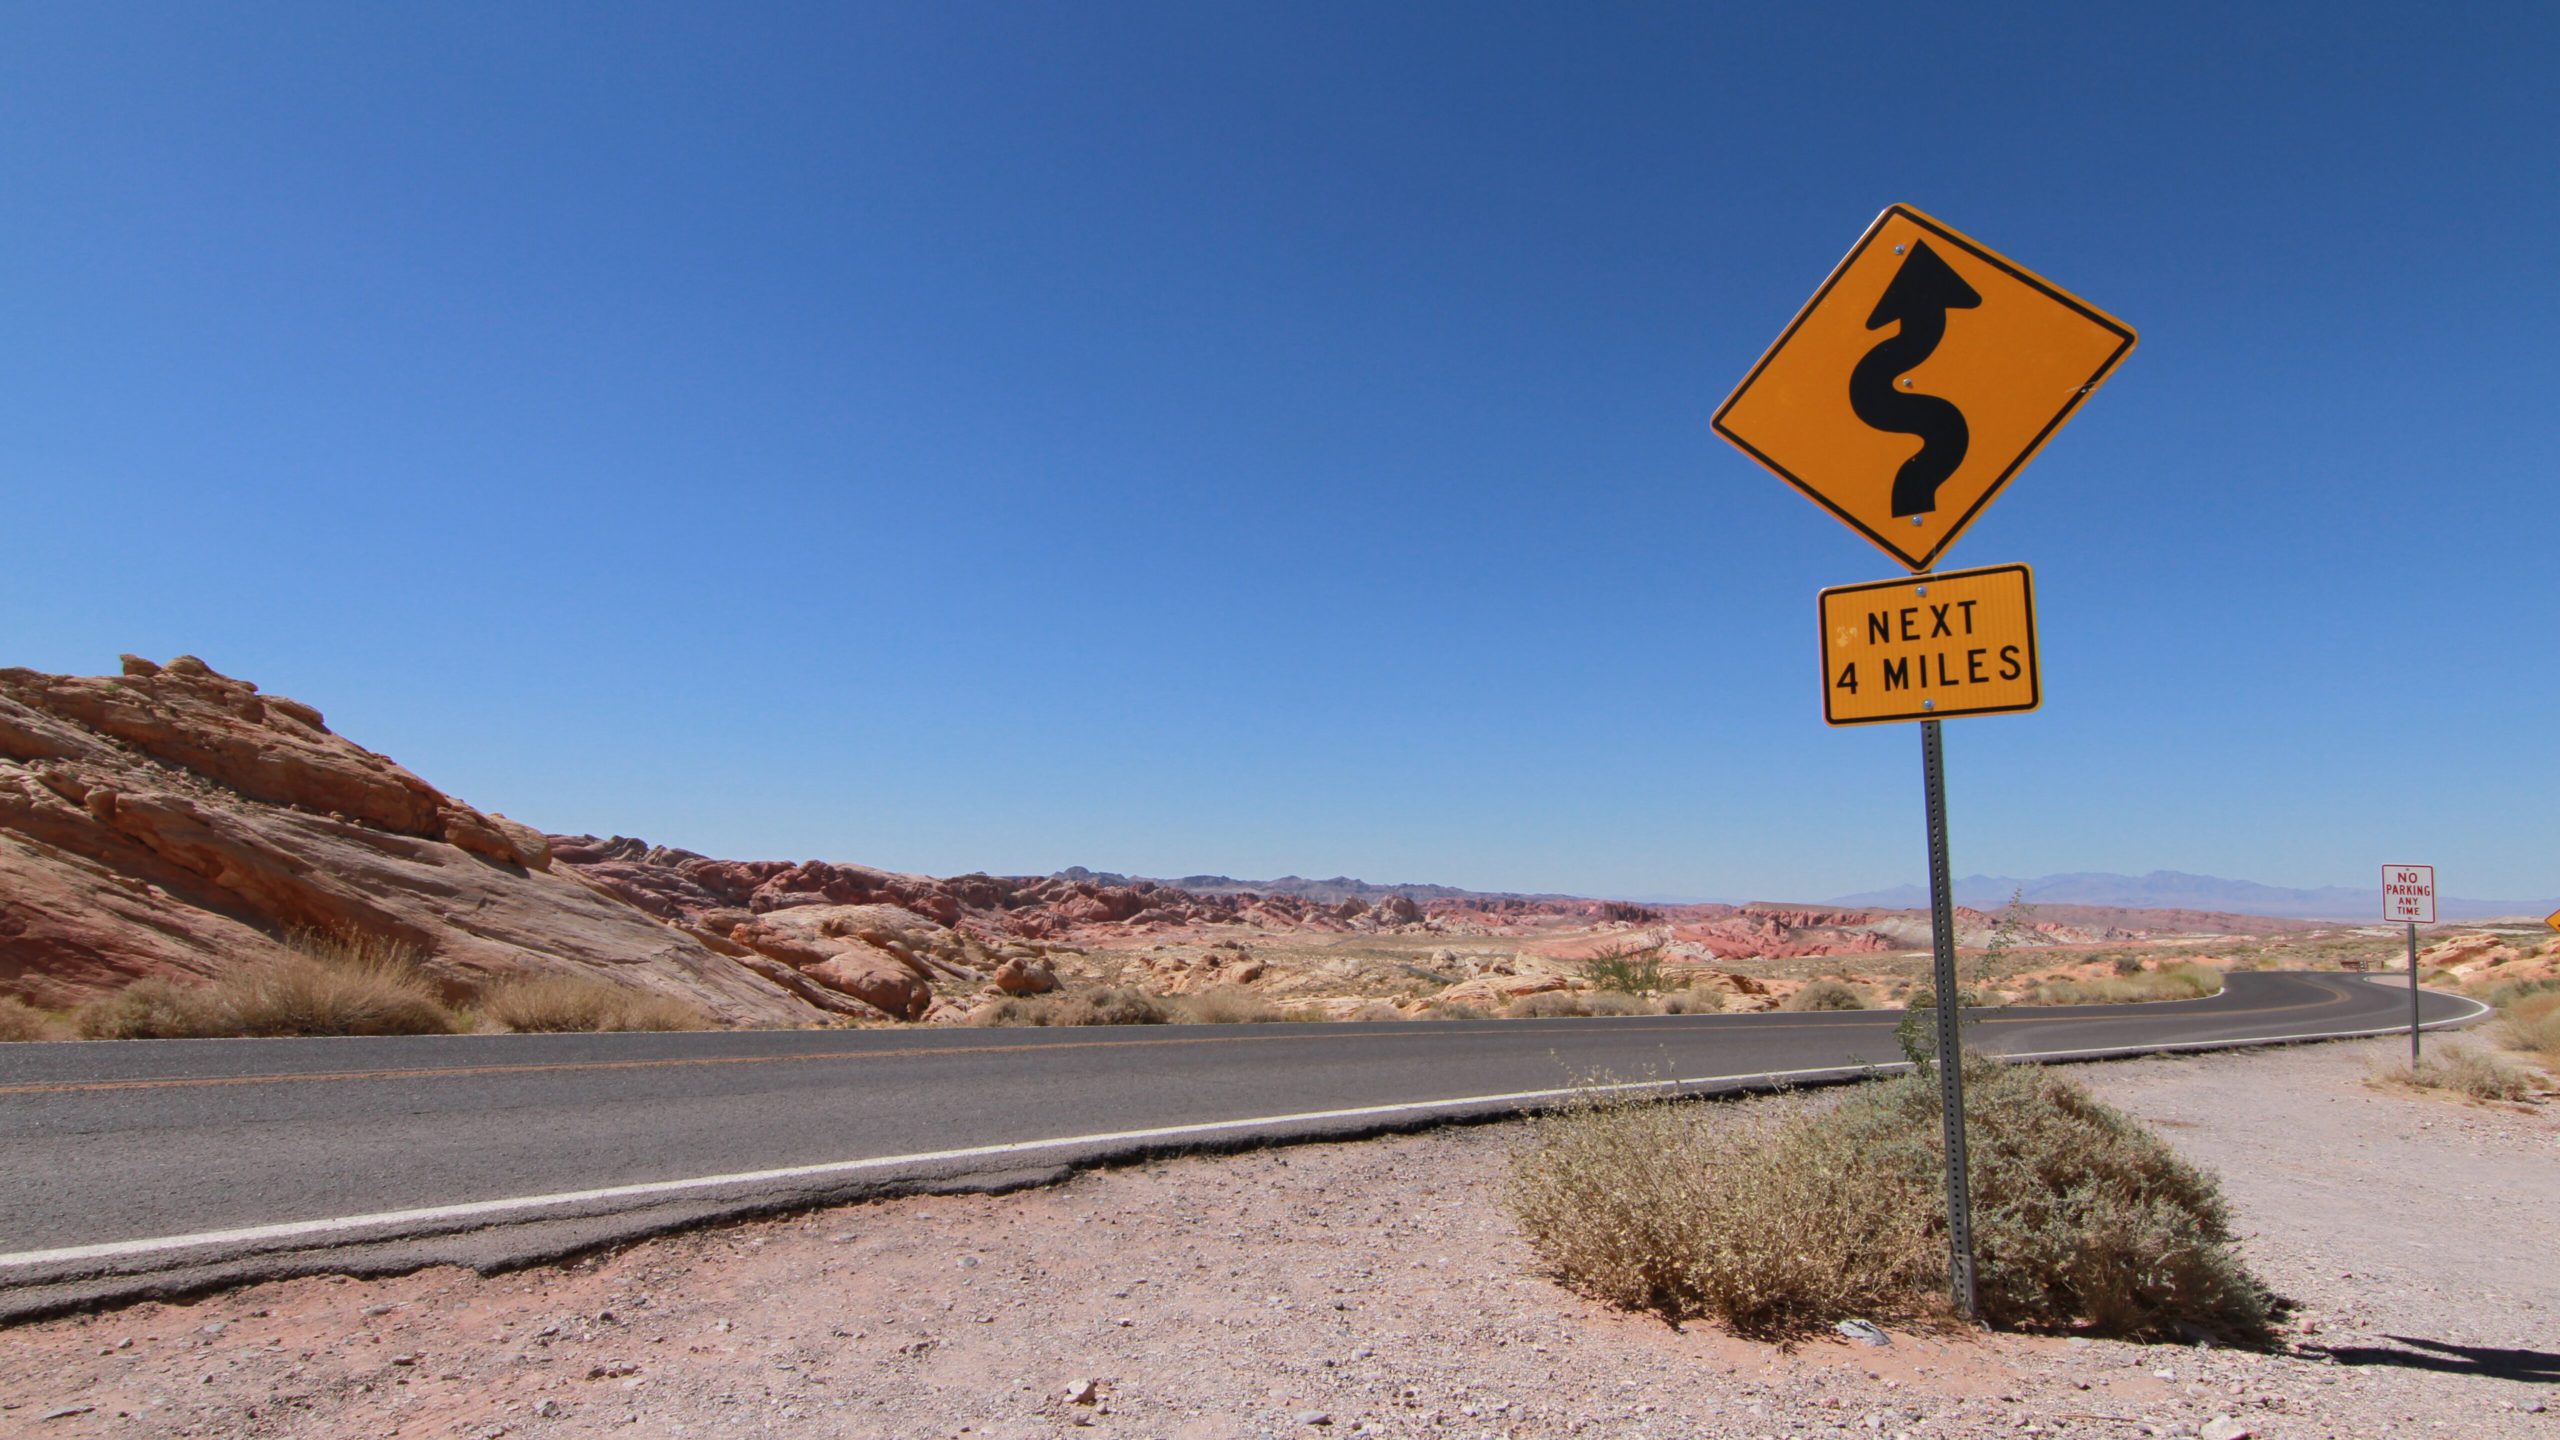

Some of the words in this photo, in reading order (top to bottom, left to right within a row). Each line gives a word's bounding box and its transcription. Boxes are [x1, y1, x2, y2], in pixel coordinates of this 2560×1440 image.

[1868, 600, 1976, 645] NEXT
[1836, 662, 1858, 694] 4
[1883, 645, 2021, 692] MILES
[2397, 872, 2417, 883] NO
[2386, 884, 2430, 896] PARKING
[2398, 897, 2418, 905] ANY
[2397, 907, 2420, 915] TIME
